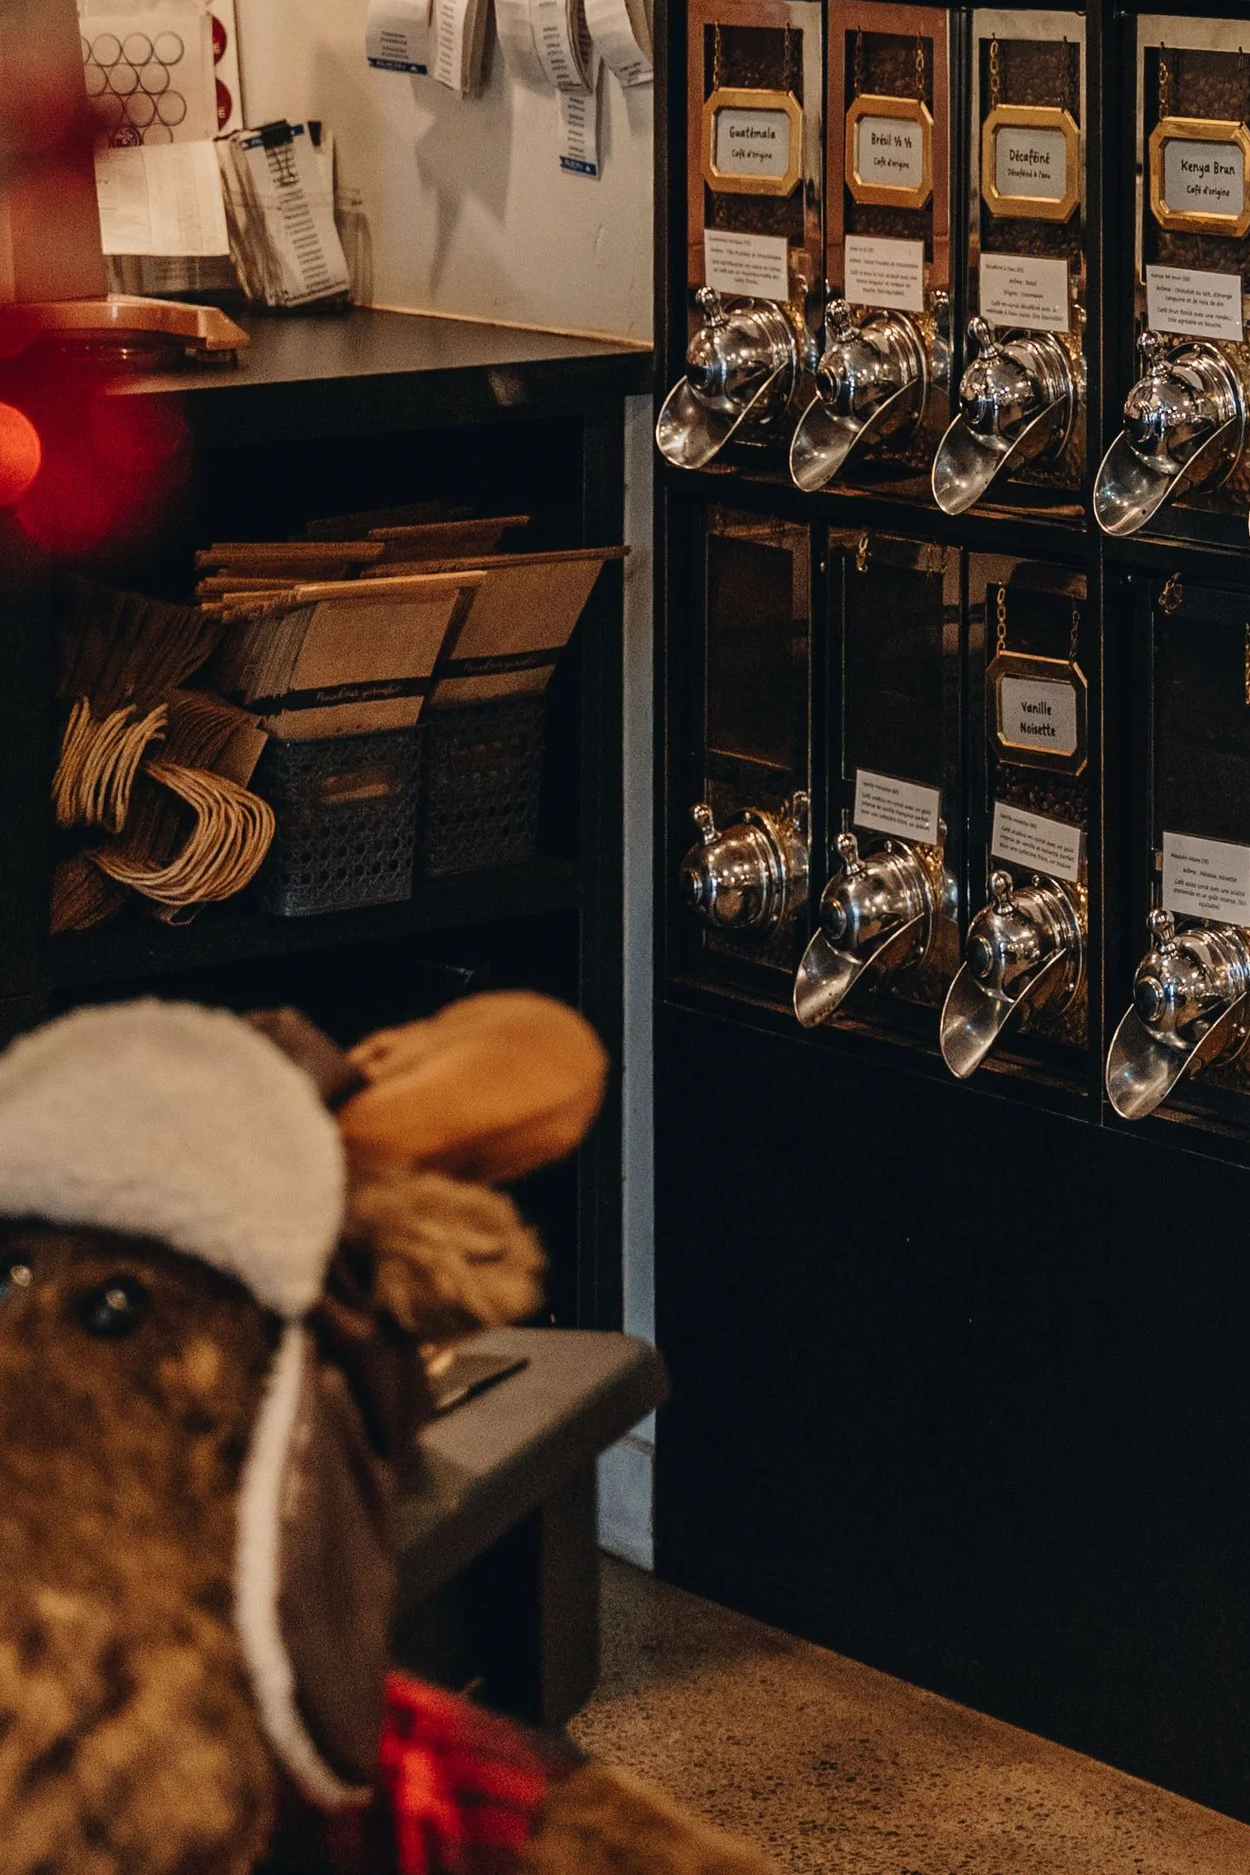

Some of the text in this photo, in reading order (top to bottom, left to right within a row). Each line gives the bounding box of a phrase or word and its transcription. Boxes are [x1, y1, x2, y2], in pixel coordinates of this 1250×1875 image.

[729, 126, 776, 139] Guatémala
[871, 132, 891, 146] Brésil
[732, 148, 745, 159] Café
[1009, 149, 1050, 165] Décaféiné
[873, 156, 886, 167] Café
[1181, 158, 1235, 178] Kenya Brun
[1186, 184, 1230, 200] Café d'origine
[1021, 701, 1052, 715] Vanille
[1020, 722, 1055, 737] Noisette
